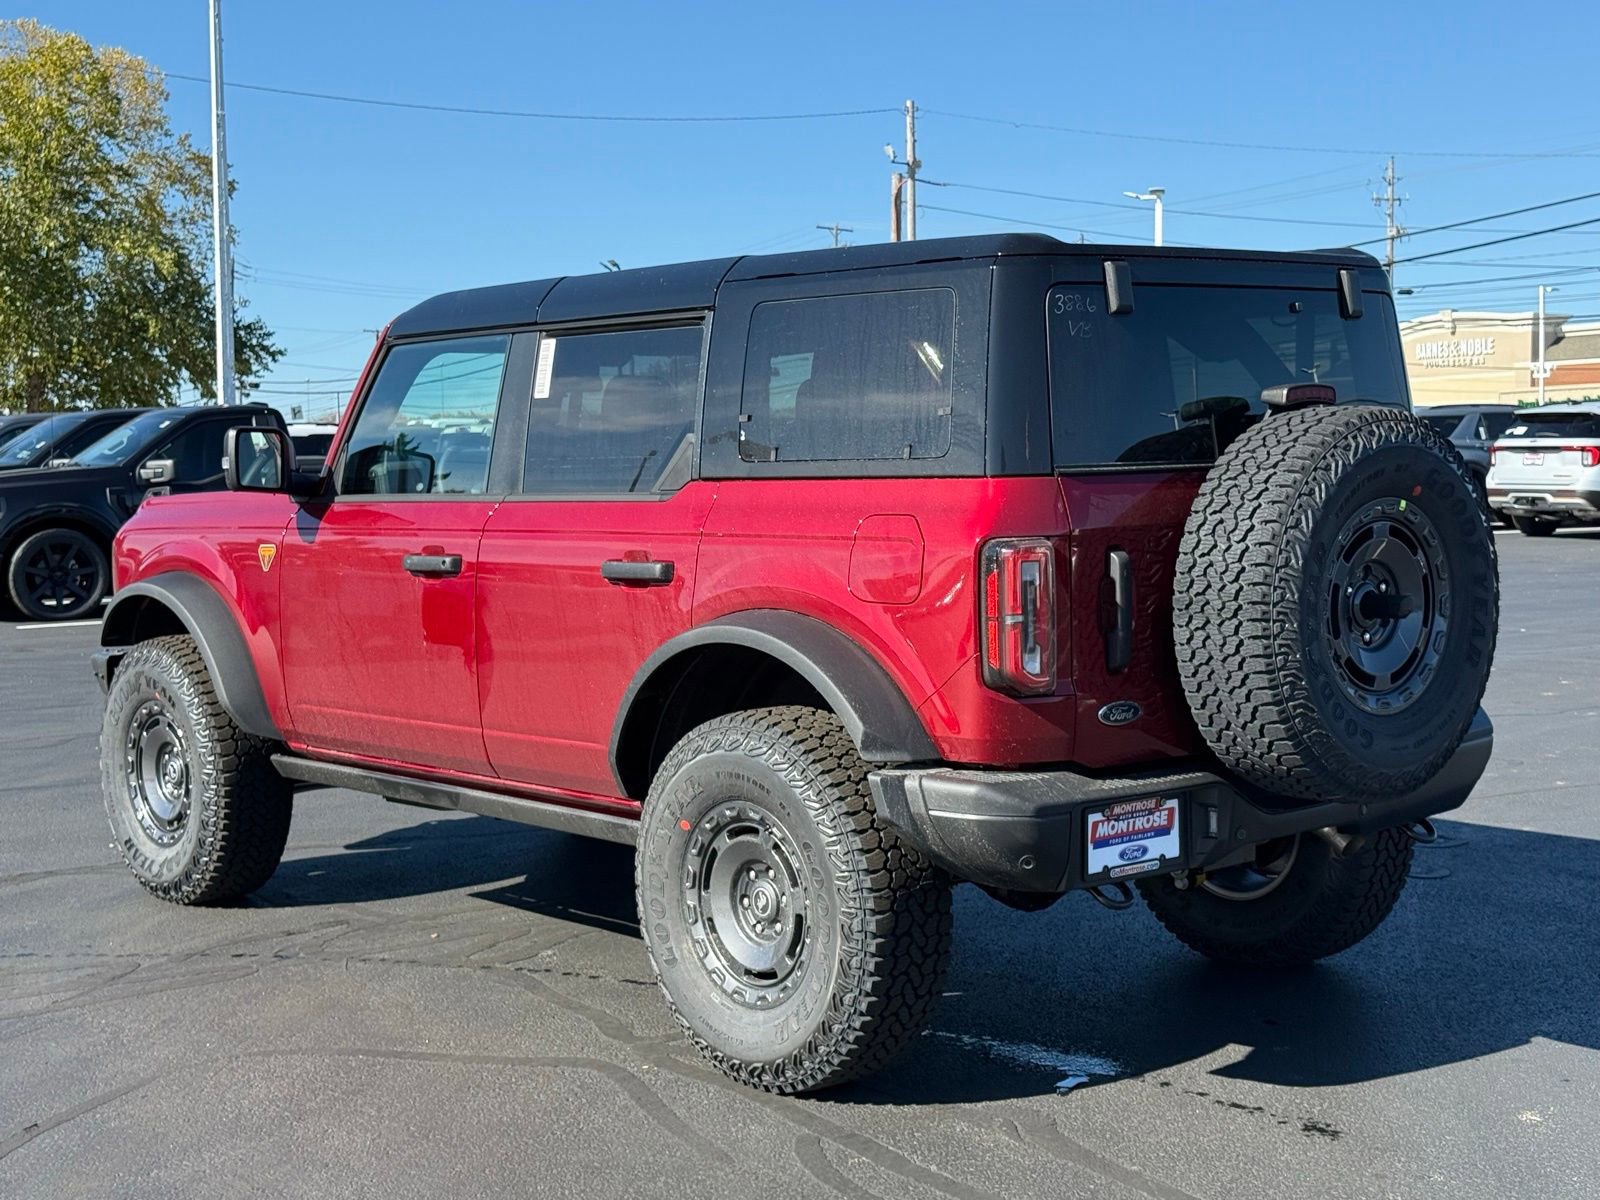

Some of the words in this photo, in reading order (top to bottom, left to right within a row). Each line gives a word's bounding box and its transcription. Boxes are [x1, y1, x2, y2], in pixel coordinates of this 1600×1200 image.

[1054, 294, 1097, 314] 3886
[1416, 343, 1450, 360] BARNES
[1450, 340, 1459, 357] &
[1460, 336, 1495, 357] NOBLE
[108, 671, 177, 727] GOODYEAR
[1112, 799, 1157, 815] MONTROSE
[1095, 810, 1169, 839] MONTROSE
[1123, 847, 1144, 859] Ford
[1111, 863, 1159, 877] GoMontrose.com
